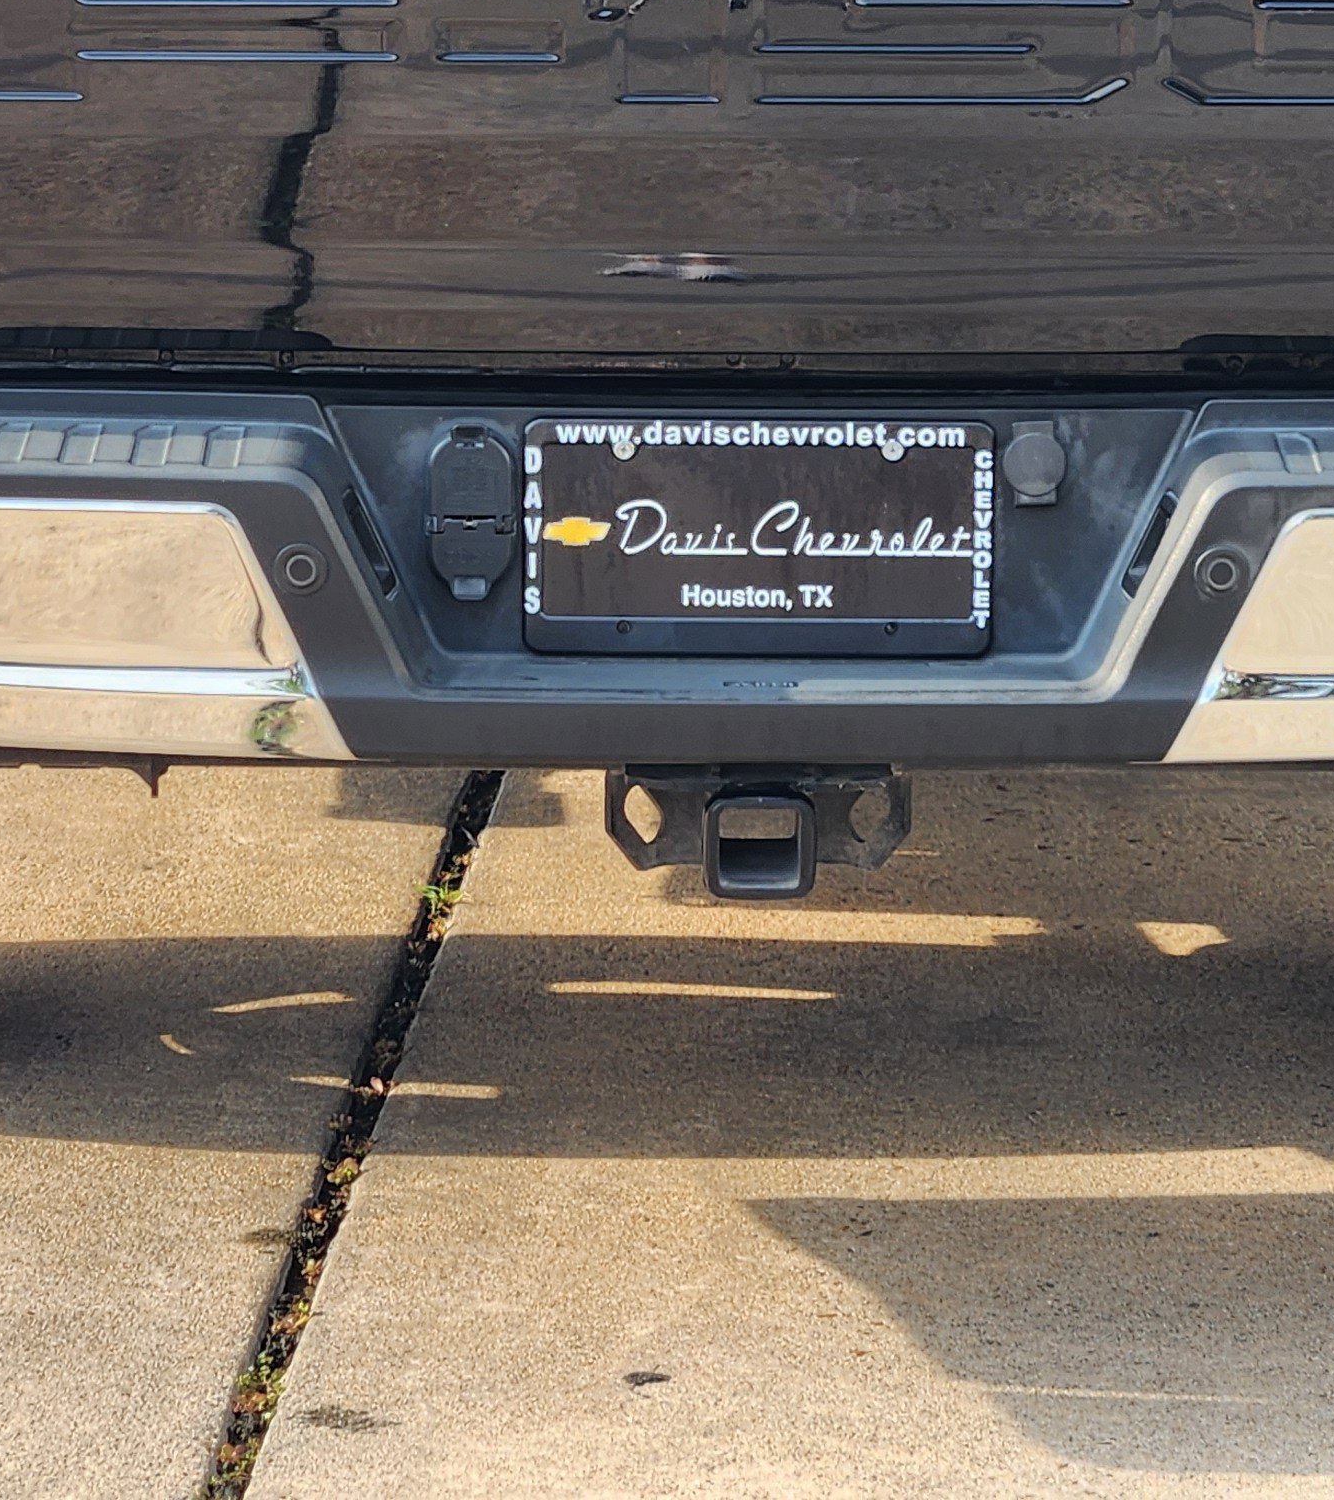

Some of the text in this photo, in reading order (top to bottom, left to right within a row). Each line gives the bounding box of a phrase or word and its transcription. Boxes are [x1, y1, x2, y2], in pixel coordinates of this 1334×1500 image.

[555, 421, 965, 448] www.davischevrolet.com
[524, 445, 543, 615] DAVIS
[614, 499, 973, 558] Davis Chevrolet
[974, 450, 993, 629] CHEVROLET
[681, 584, 833, 611] Houston, TX
